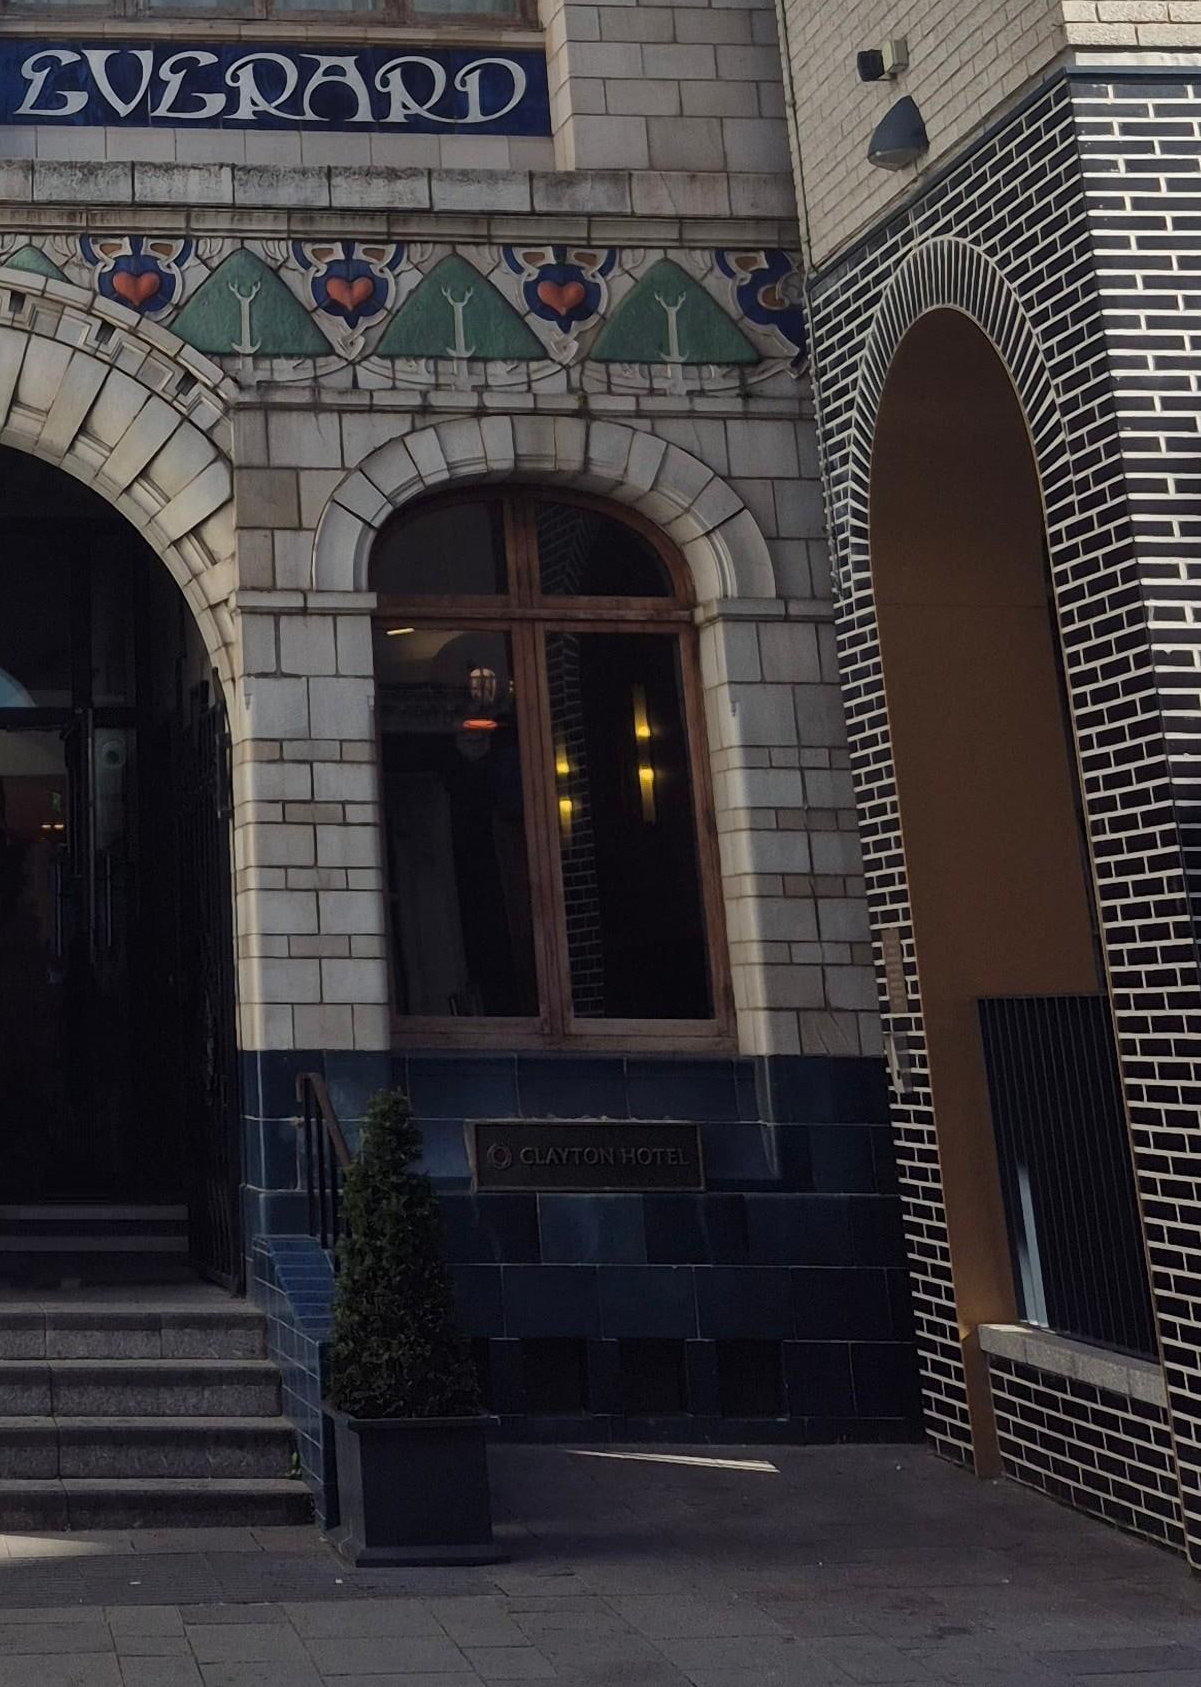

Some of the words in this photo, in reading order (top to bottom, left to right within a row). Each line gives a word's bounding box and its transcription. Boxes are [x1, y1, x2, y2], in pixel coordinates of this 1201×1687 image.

[12, 48, 528, 125] EVERARD
[519, 1146, 616, 1166] CLAYTON
[620, 1146, 691, 1166] HOTEL
